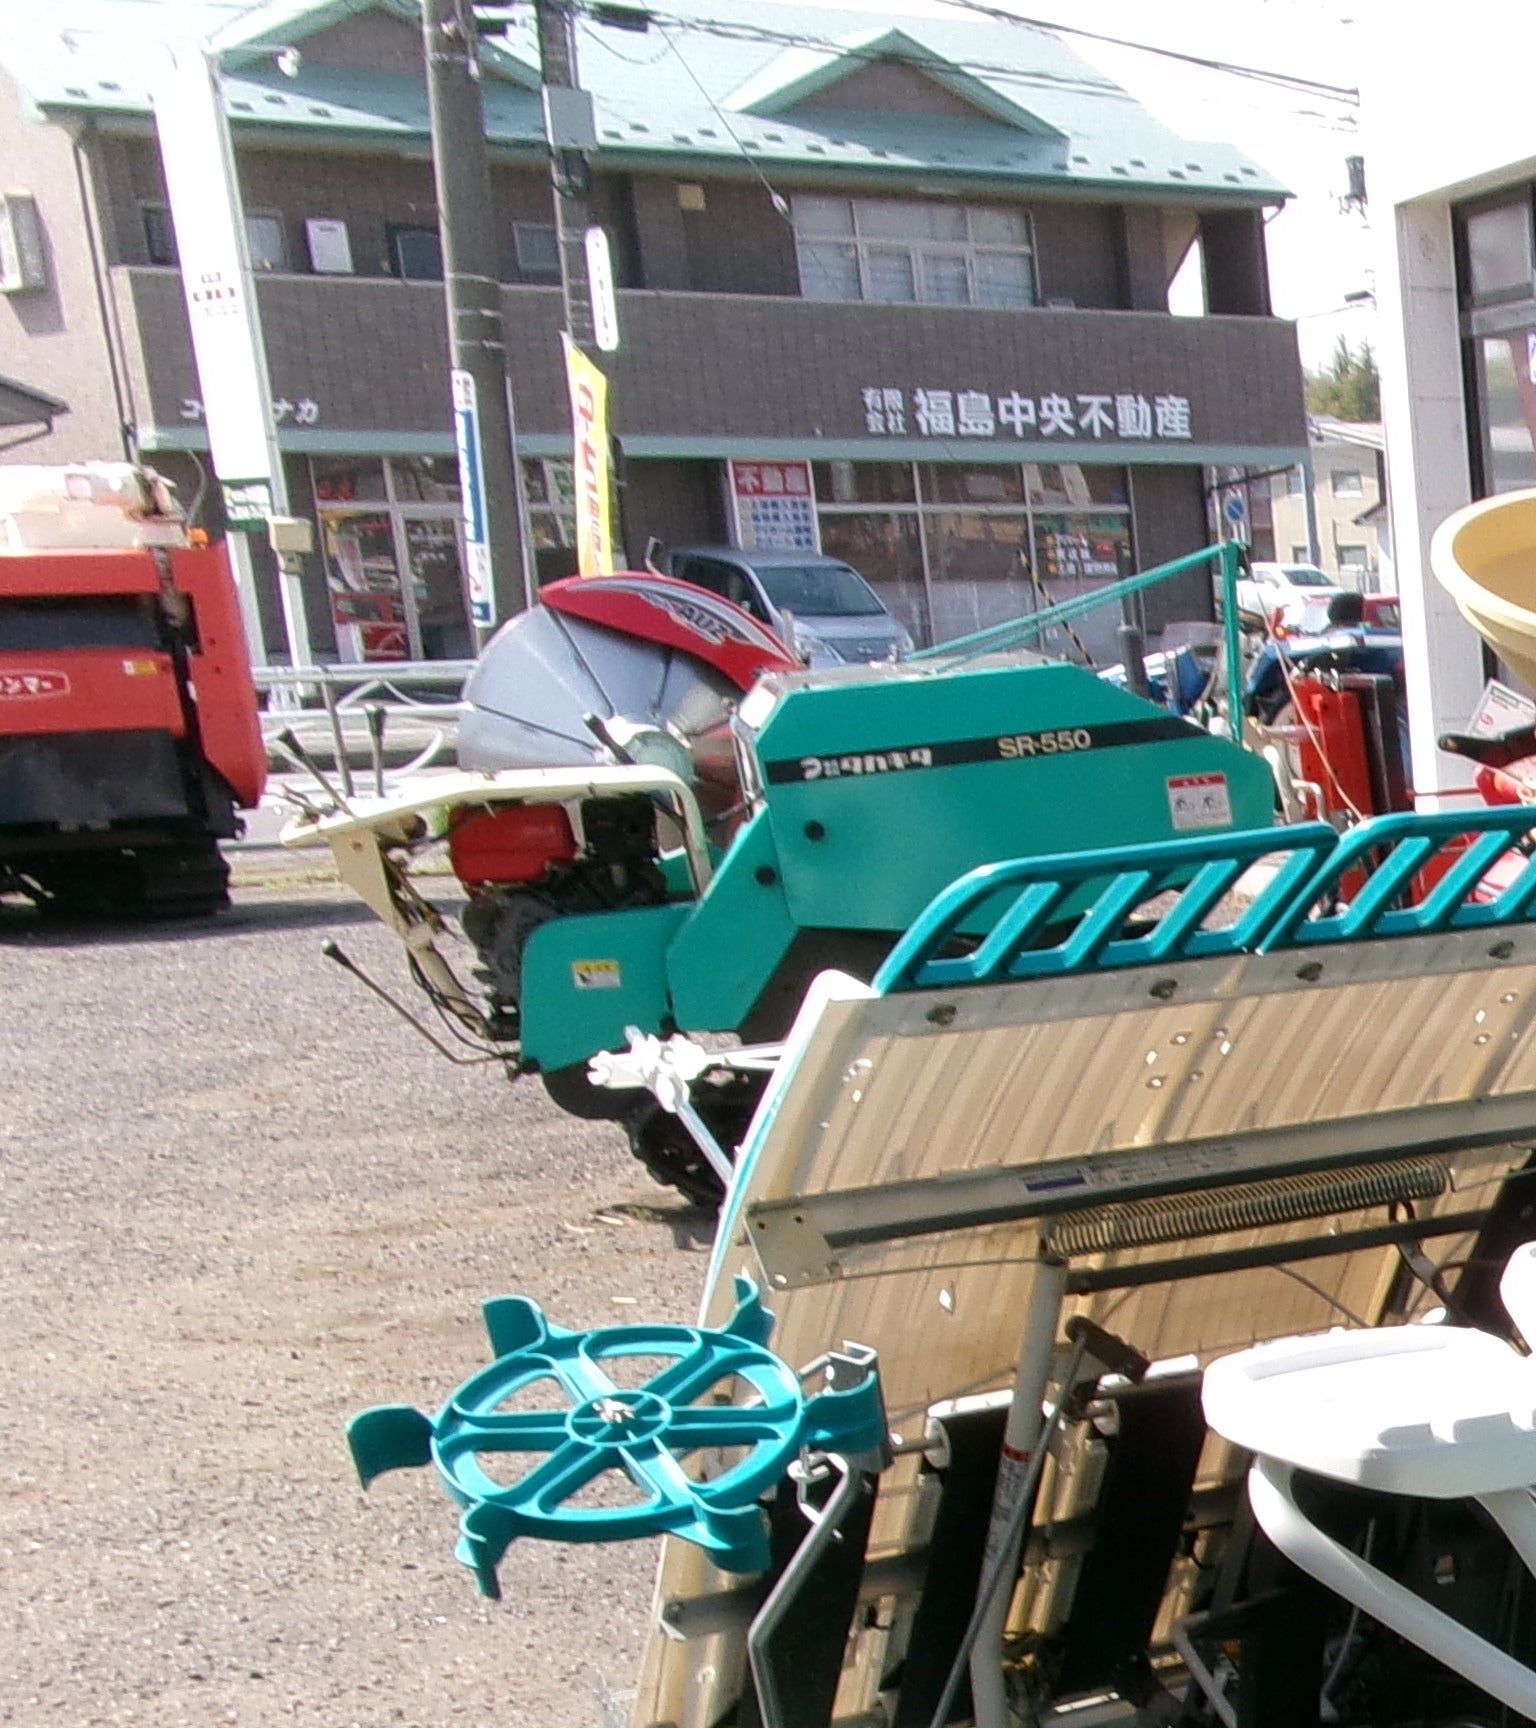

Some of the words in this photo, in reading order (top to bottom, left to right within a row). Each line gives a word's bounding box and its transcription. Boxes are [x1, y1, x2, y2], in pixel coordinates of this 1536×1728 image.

[912, 388, 1193, 440] 福島中央不動産
[0, 674, 53, 695] ンマー
[997, 728, 1092, 759] SR-550
